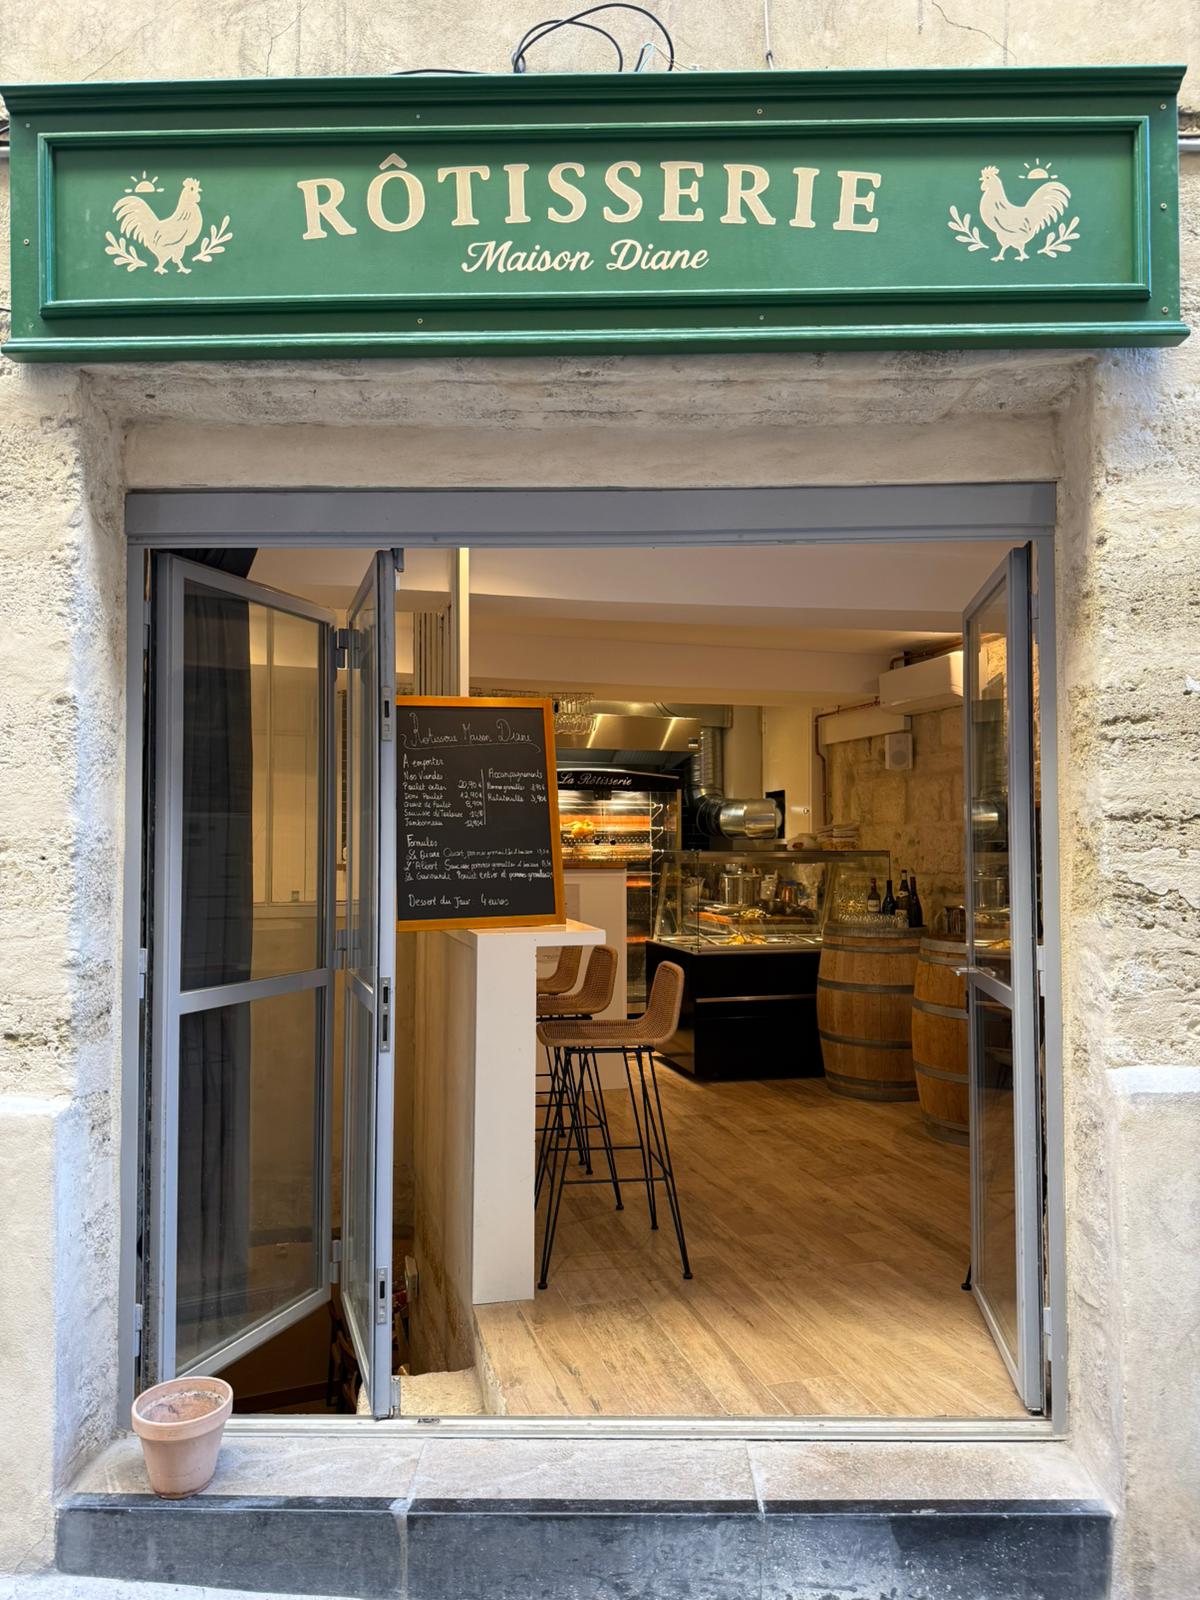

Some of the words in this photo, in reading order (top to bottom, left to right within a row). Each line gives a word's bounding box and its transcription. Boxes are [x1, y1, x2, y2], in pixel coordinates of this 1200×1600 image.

[297, 153, 882, 240] RÔTISSERIE
[461, 240, 595, 273] Maison
[606, 239, 710, 271] Diane
[496, 719, 532, 743] Diane
[558, 772, 574, 785] La
[440, 895, 451, 905] du
